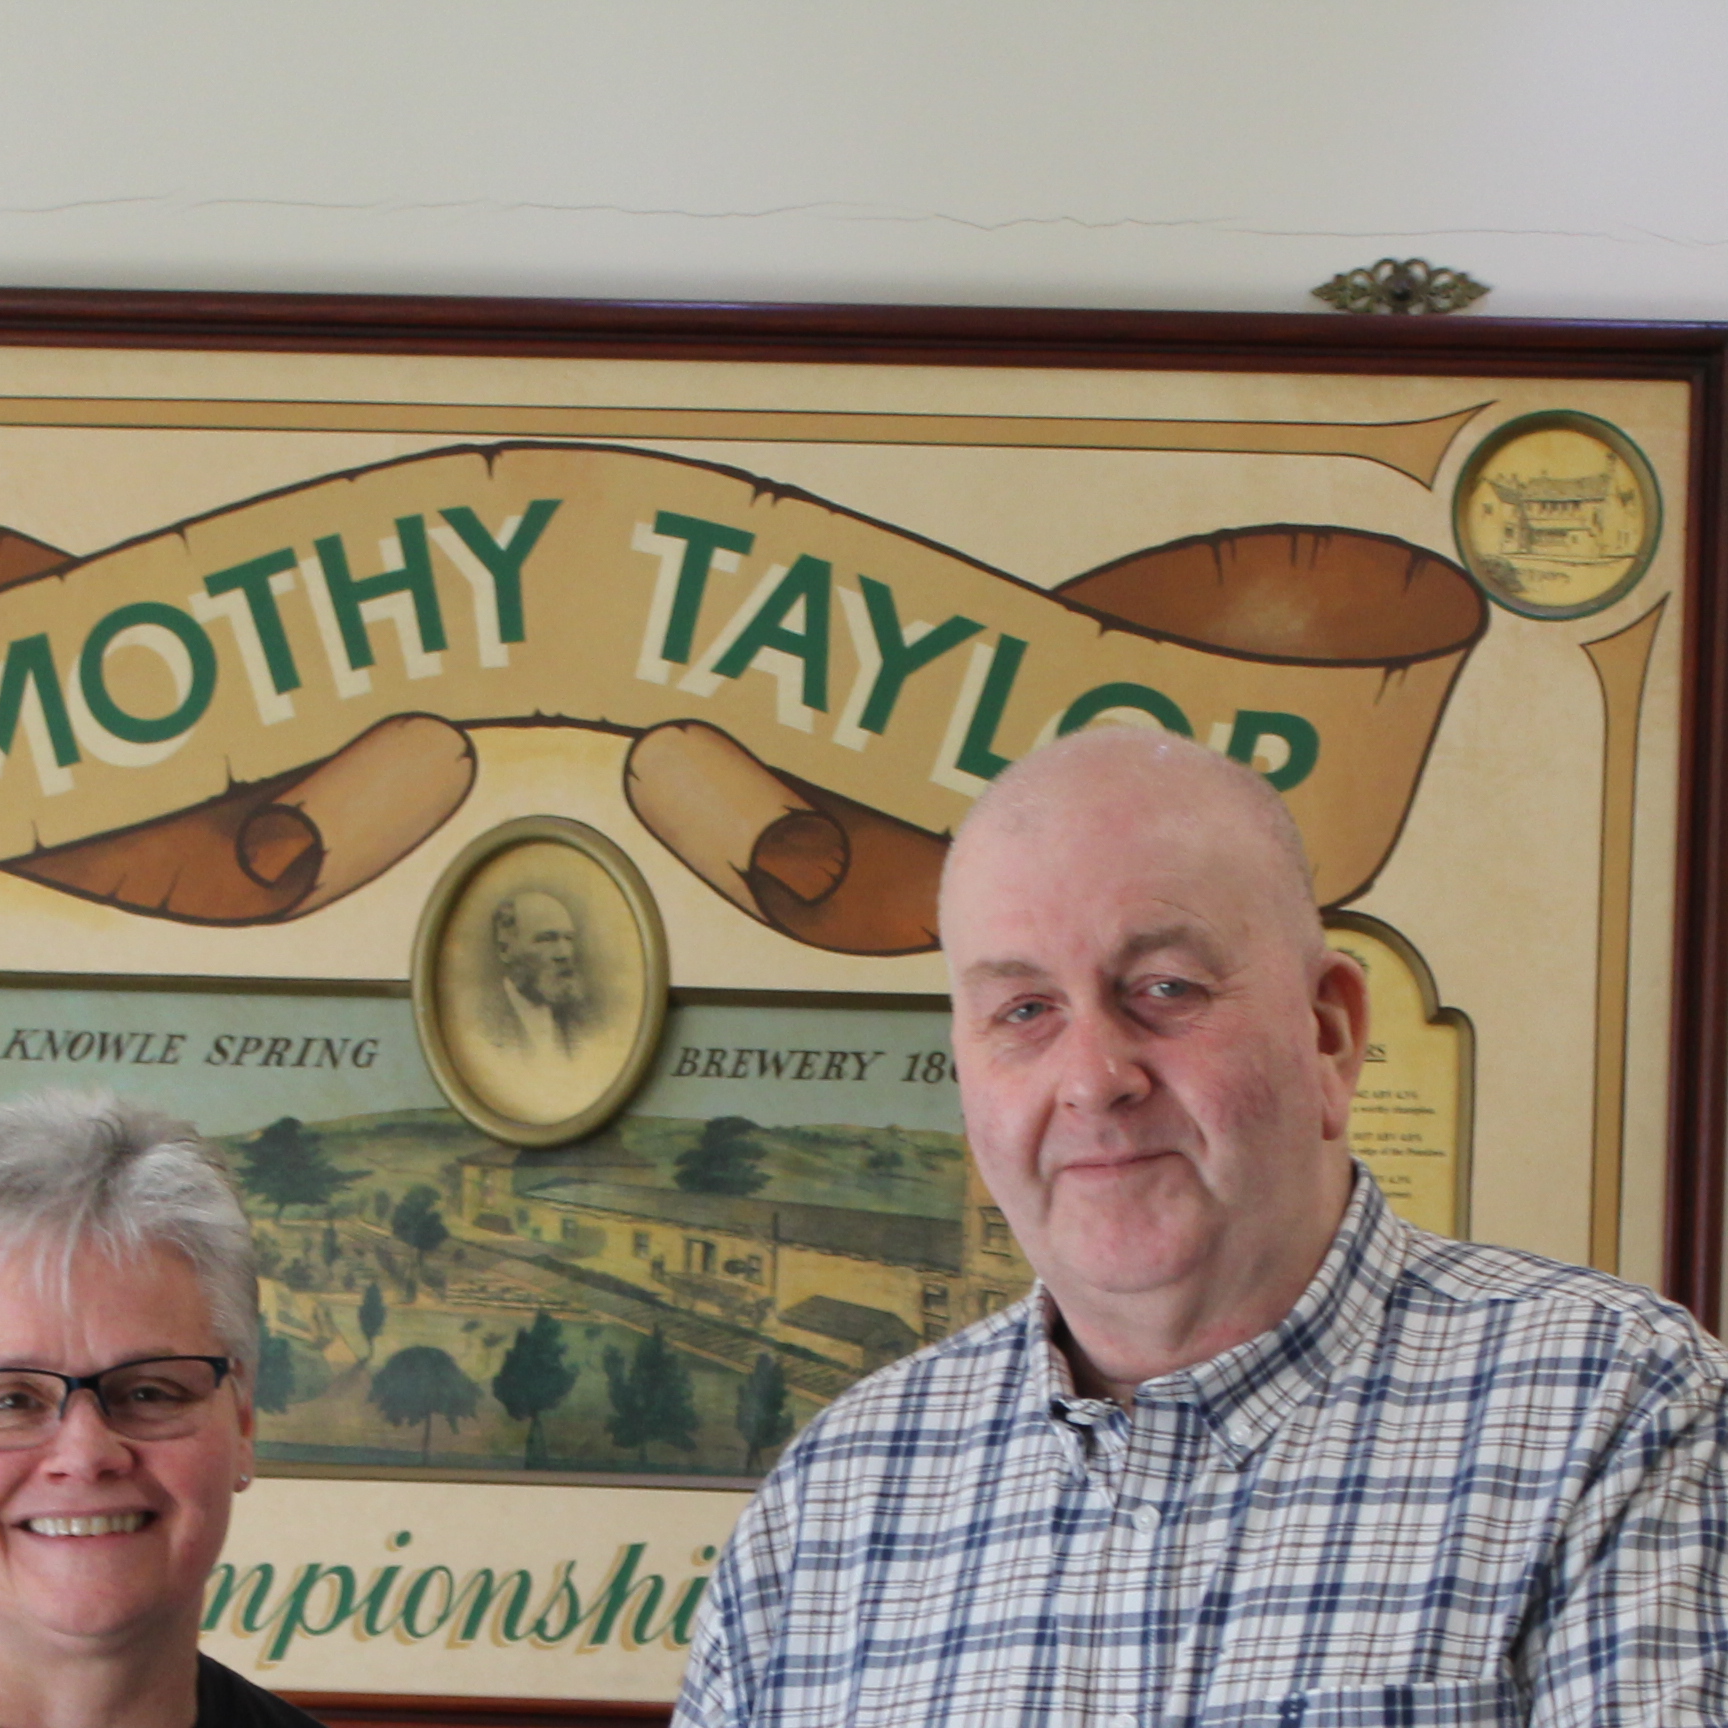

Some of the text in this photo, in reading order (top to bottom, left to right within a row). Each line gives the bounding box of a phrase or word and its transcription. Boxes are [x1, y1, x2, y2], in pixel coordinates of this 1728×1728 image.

[0, 1028, 186, 1064] KNOWLE
[204, 1033, 379, 1069] SPRING
[671, 1046, 886, 1081] BREWERY
[199, 1531, 716, 1662] mpionshi
